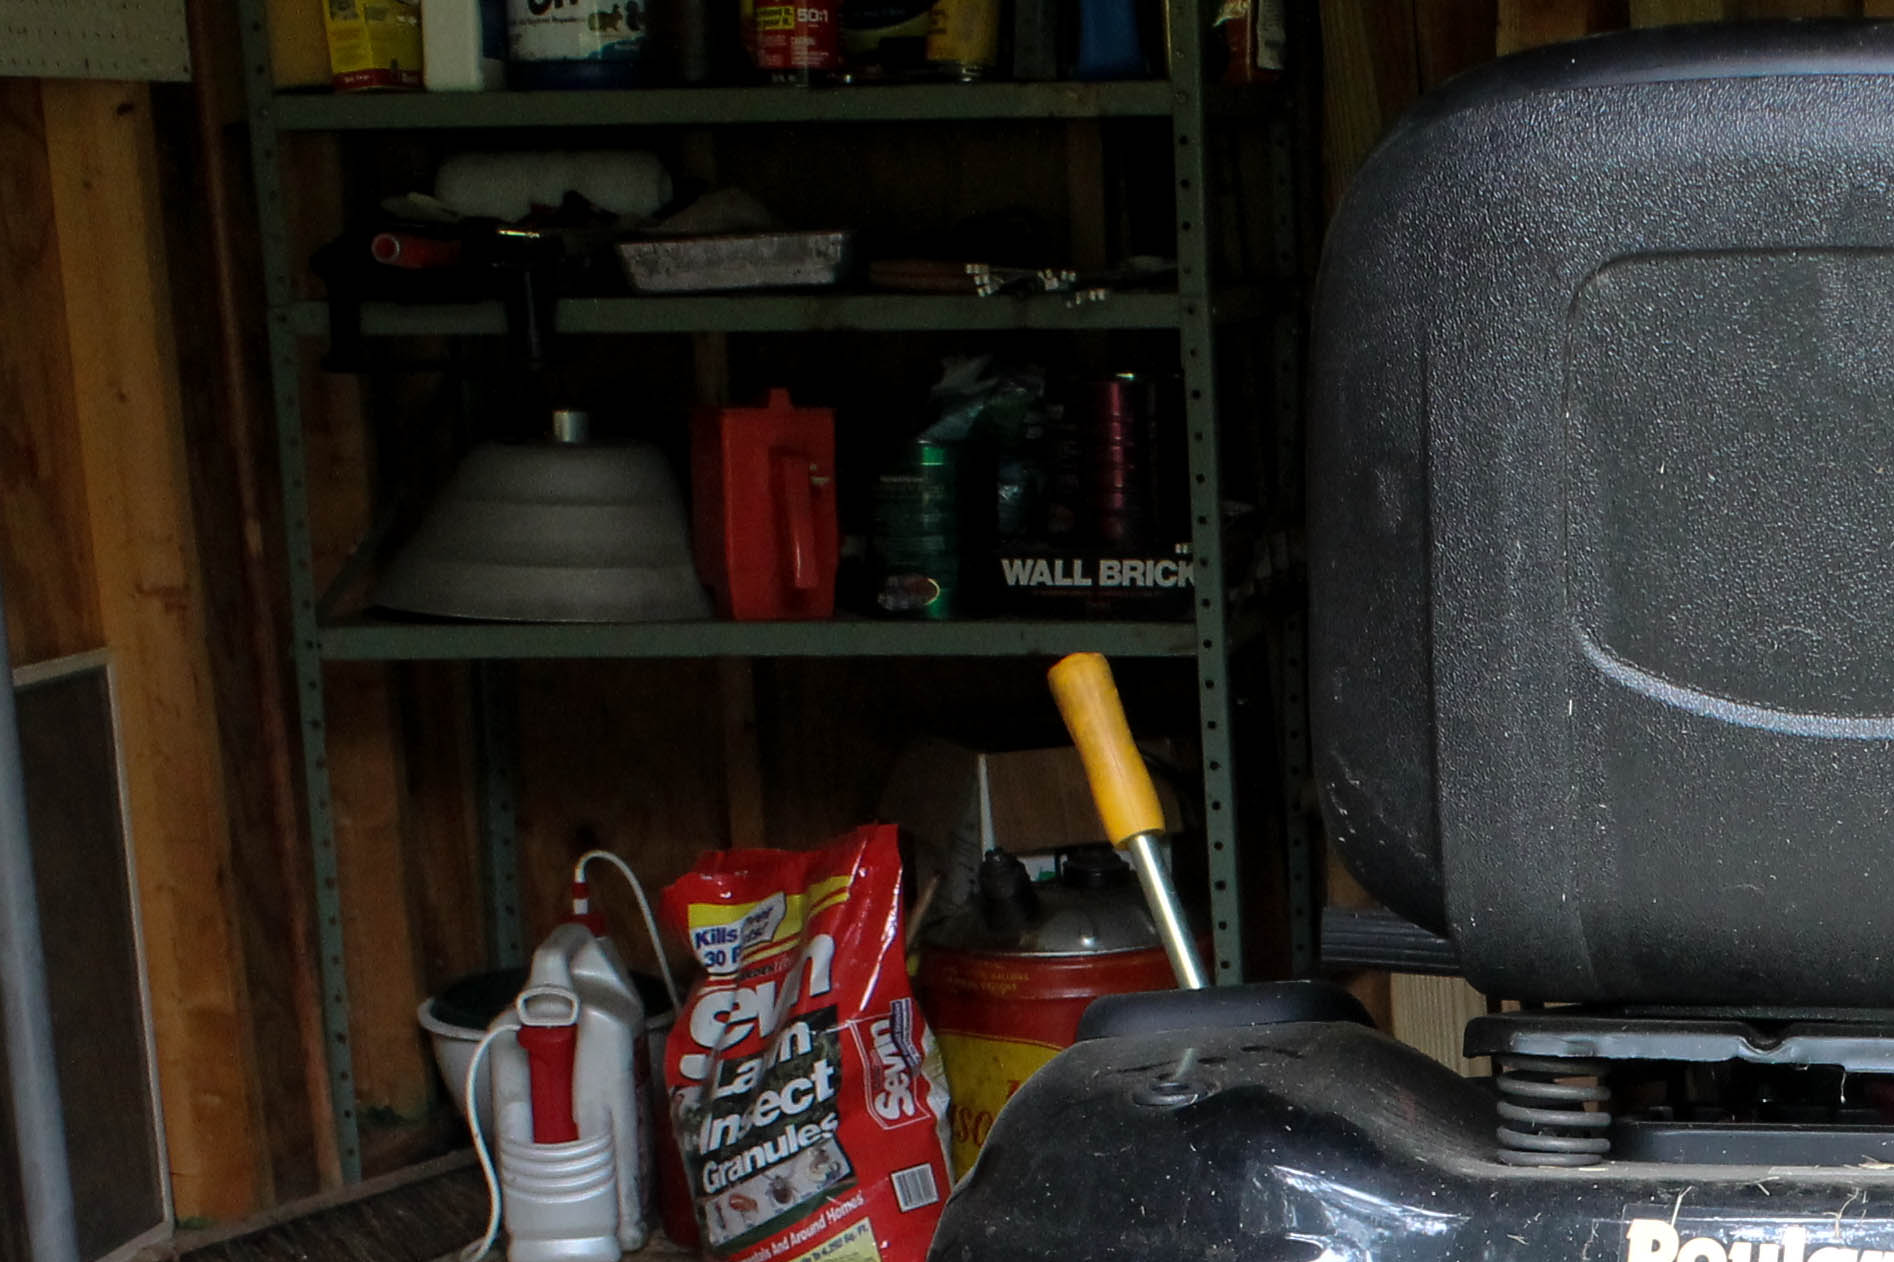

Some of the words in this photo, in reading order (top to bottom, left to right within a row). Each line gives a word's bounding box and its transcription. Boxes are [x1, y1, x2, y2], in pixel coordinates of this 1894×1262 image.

[797, 7, 829, 23] 50:1
[1001, 558, 1093, 587] WALL
[1098, 558, 1195, 588] BRICK
[694, 927, 738, 950] Kills
[703, 950, 727, 967] 30
[712, 1020, 813, 1101] Lan
[700, 1057, 836, 1155] Insect
[702, 1111, 839, 1195] Granules
[789, 1215, 828, 1246] Around
[826, 1193, 866, 1223] Homes
